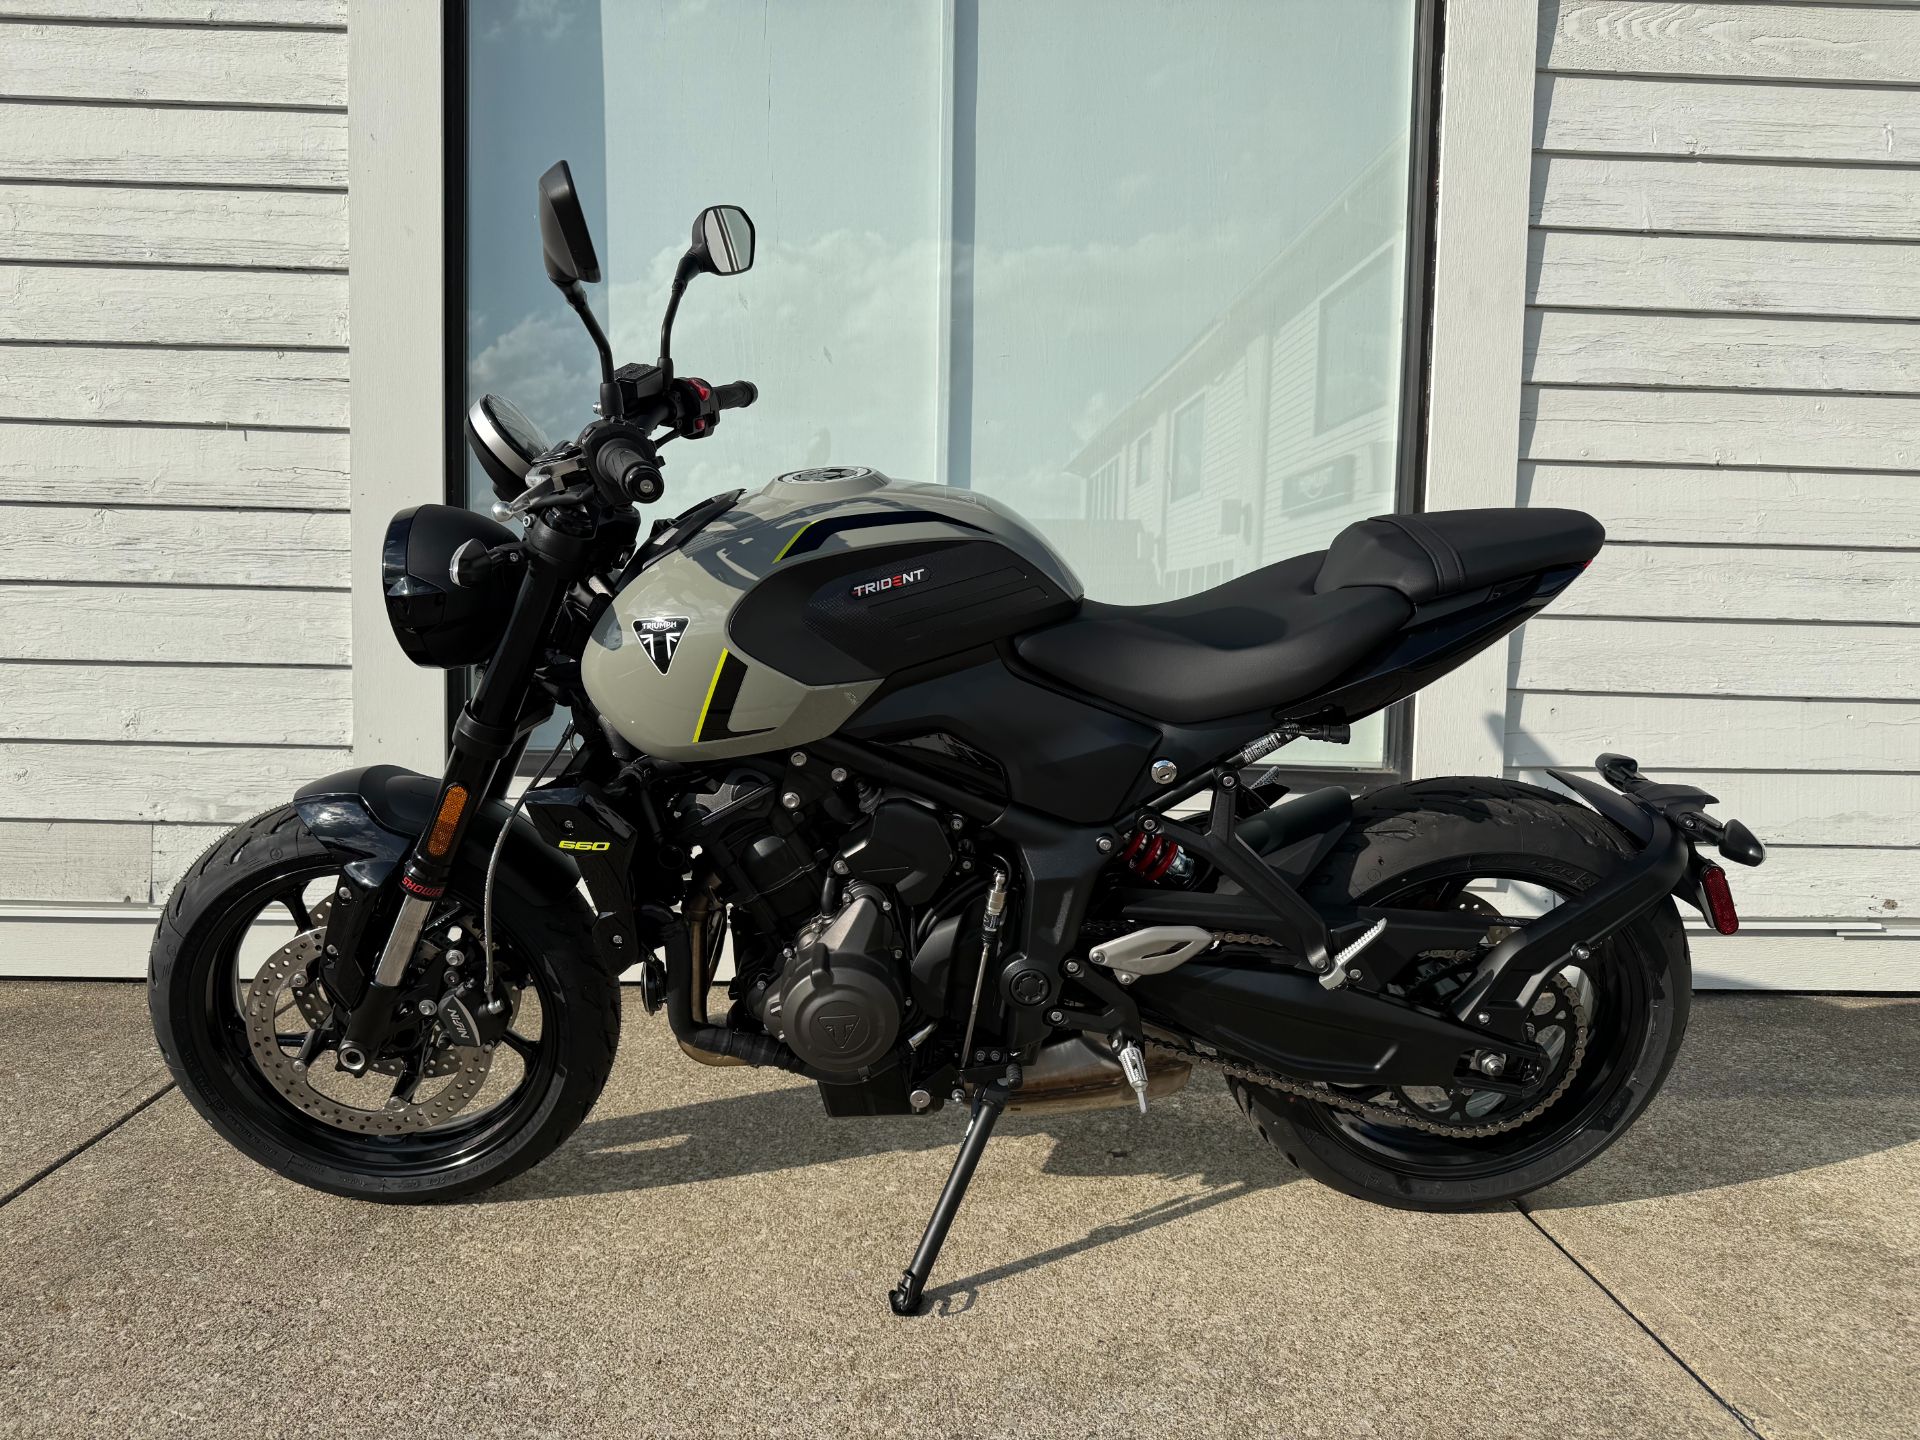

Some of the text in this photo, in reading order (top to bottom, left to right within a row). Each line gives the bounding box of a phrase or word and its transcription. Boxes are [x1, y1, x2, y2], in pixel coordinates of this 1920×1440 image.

[853, 568, 925, 597] TRIDENT
[642, 621, 677, 630] TRIUMPH
[558, 840, 611, 851] 660
